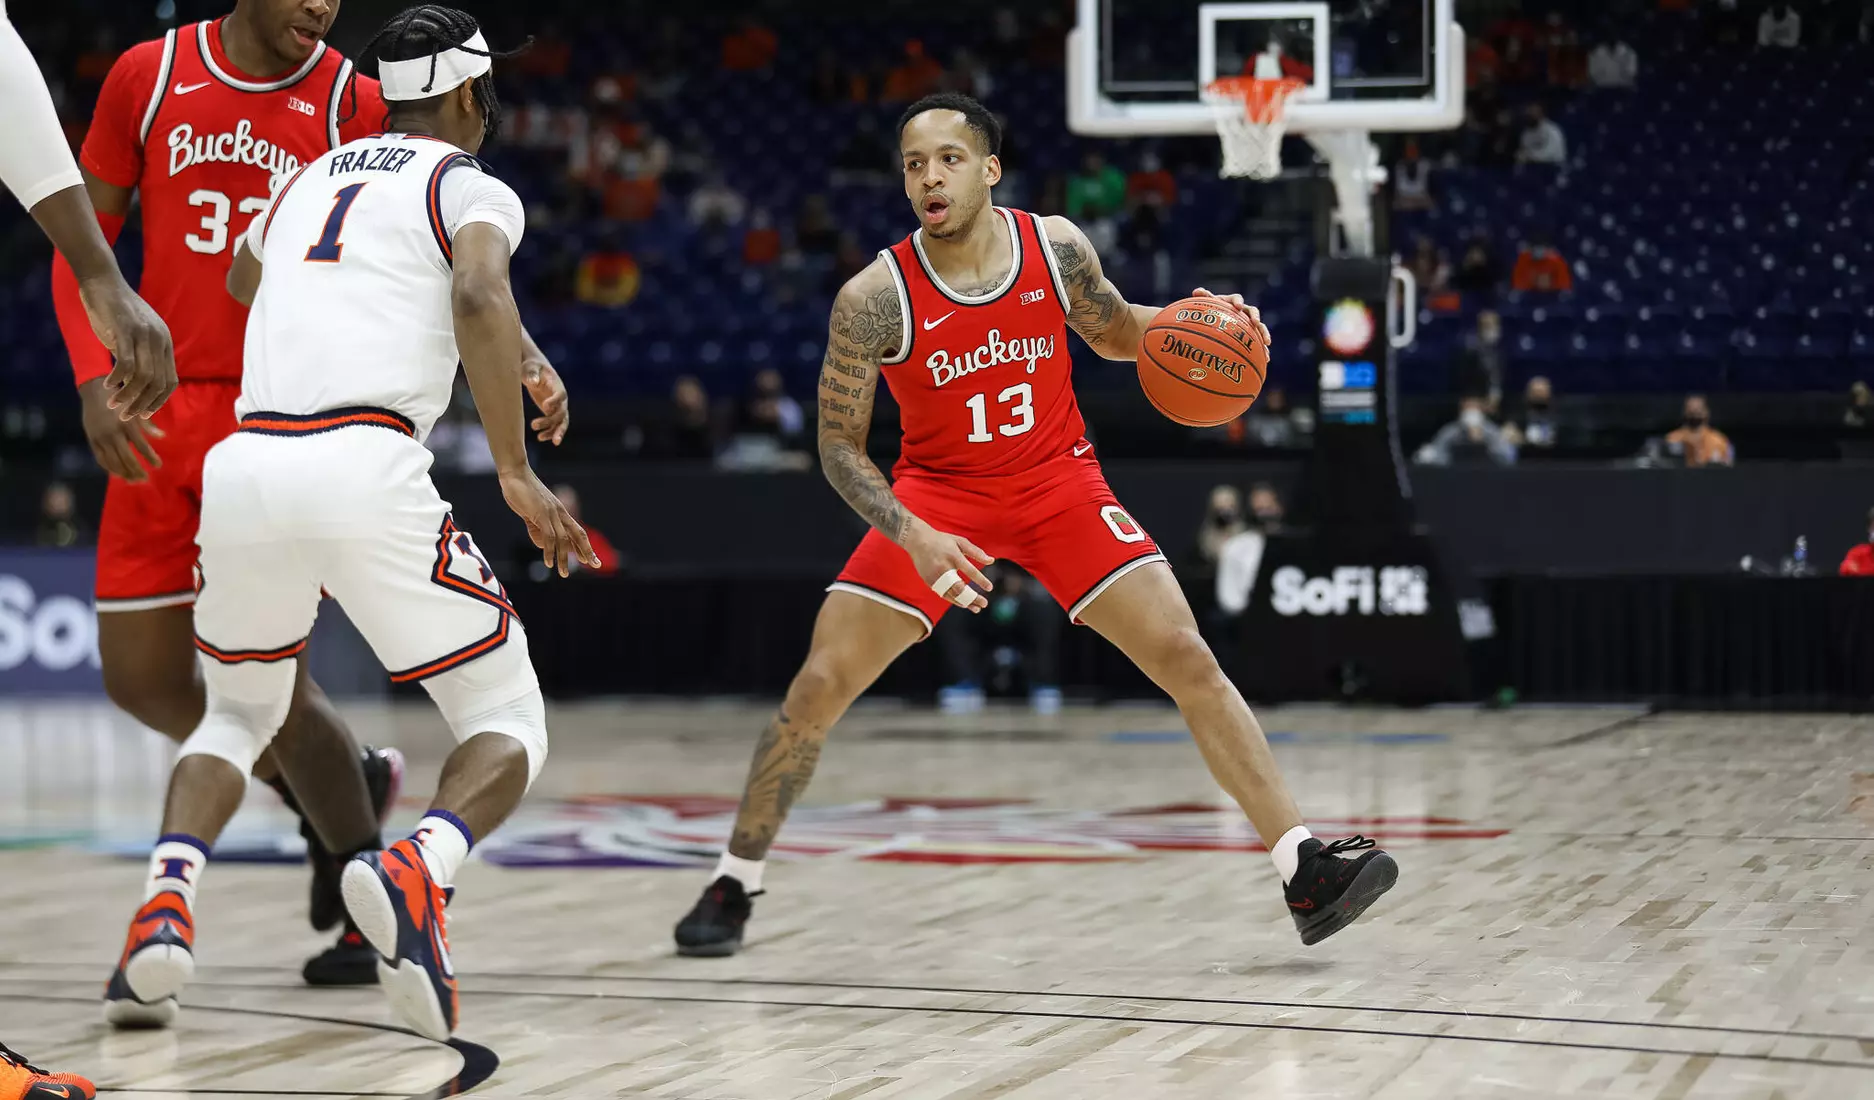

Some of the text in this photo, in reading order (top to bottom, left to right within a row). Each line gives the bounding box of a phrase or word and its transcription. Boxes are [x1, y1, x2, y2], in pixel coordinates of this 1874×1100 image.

[167, 118, 308, 192] Buckeye
[329, 147, 416, 177] FRAZIER
[303, 181, 370, 263] 1
[925, 328, 1055, 387] Buckeyes
[1161, 333, 1246, 384] SPALDING
[965, 382, 1036, 444] 13
[1271, 565, 1376, 617] SoFi
[0, 573, 101, 672] So
